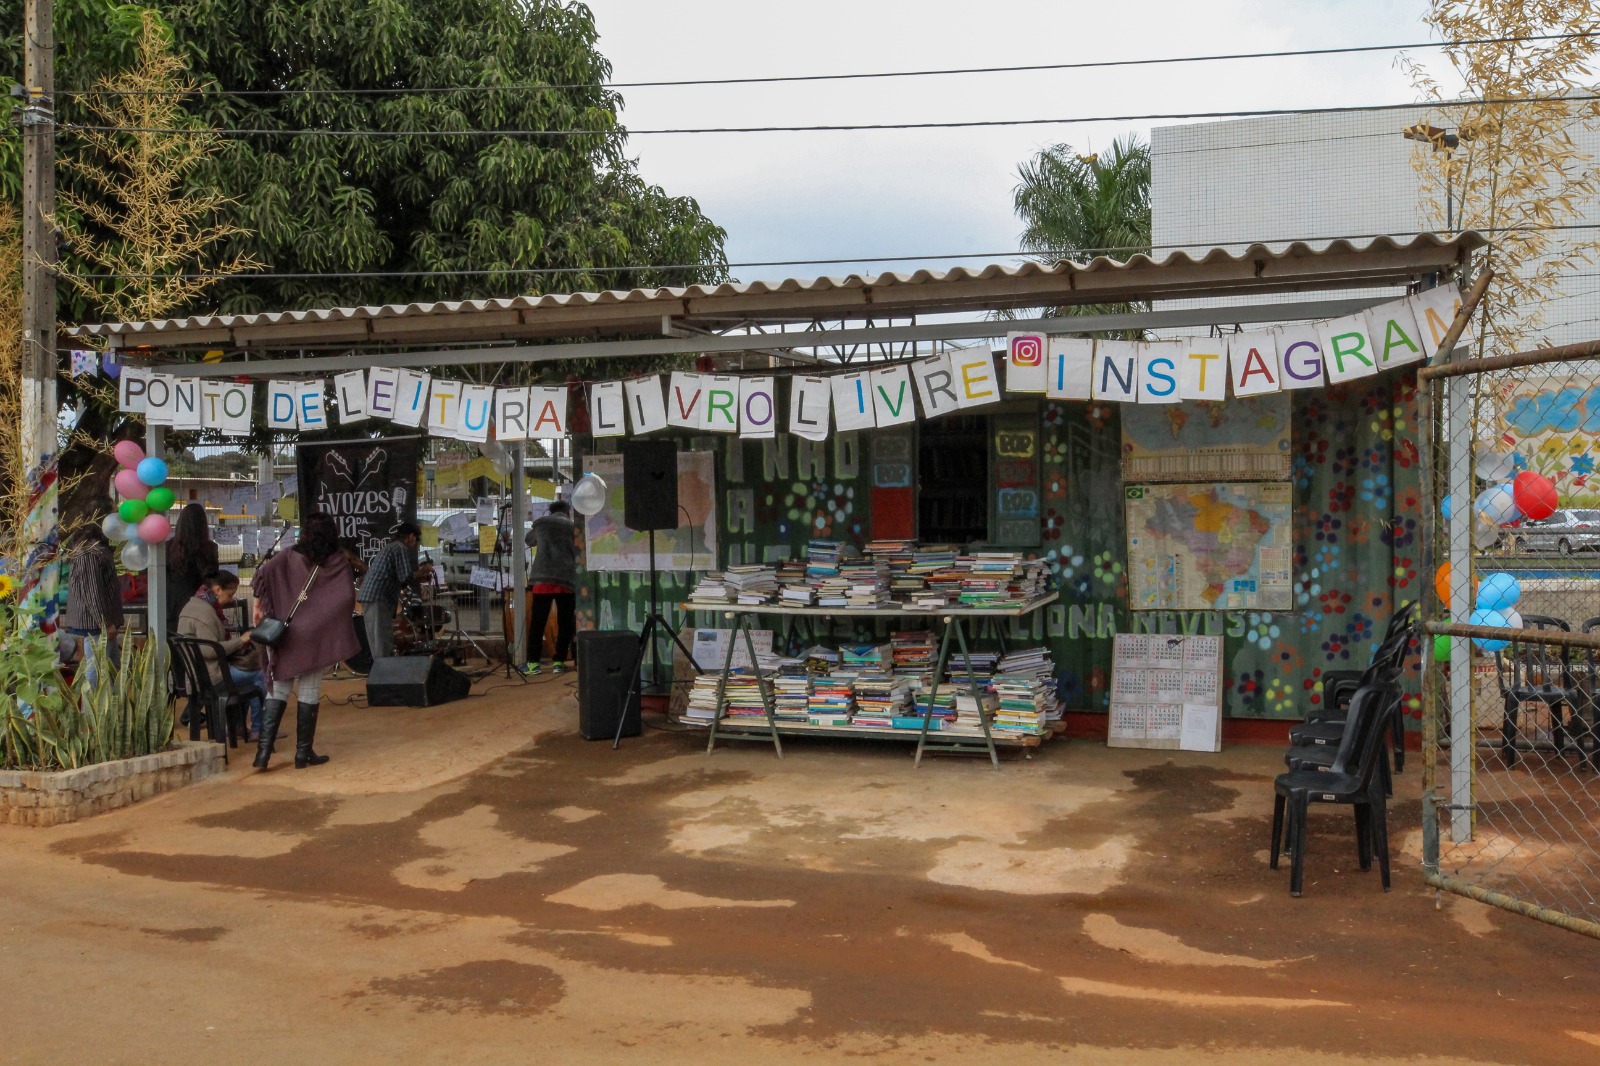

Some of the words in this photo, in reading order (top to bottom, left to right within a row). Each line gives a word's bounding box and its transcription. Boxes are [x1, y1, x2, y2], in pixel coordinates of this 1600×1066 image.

[124, 376, 247, 421] PONTO
[272, 391, 320, 423] DE
[339, 380, 562, 432] LEITURA
[597, 385, 773, 429] LIVRO
[797, 360, 993, 425] LIVRE
